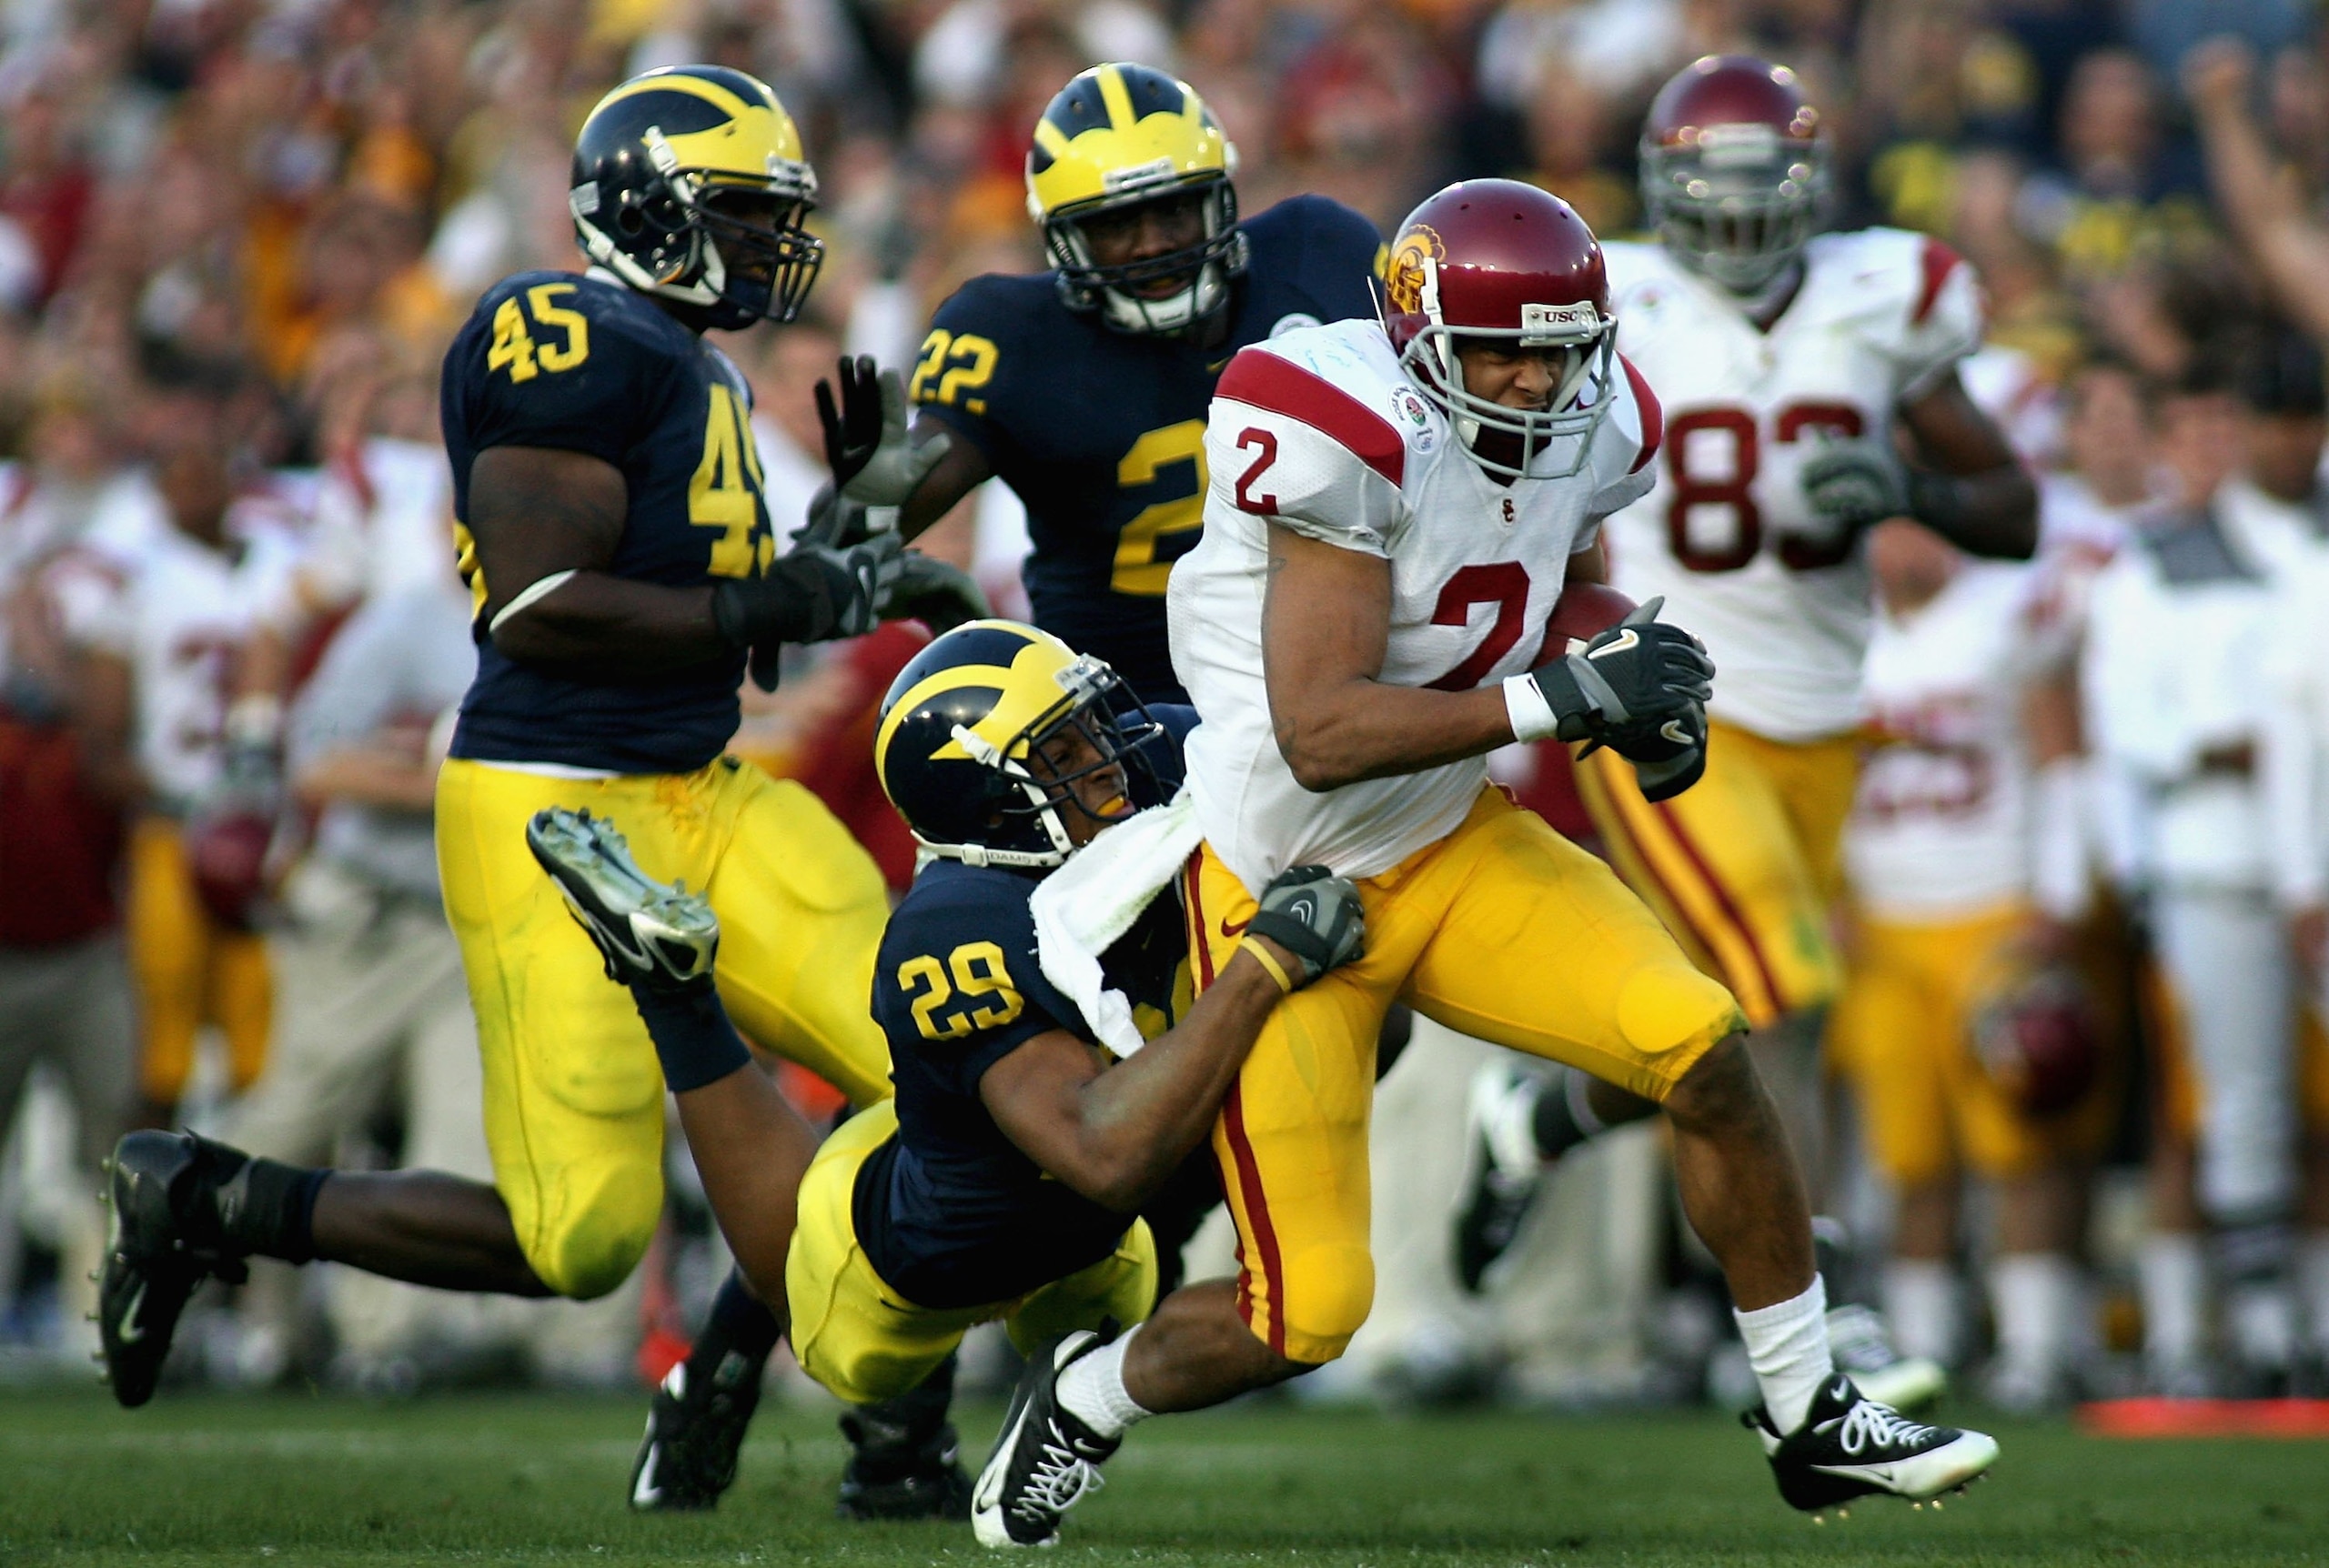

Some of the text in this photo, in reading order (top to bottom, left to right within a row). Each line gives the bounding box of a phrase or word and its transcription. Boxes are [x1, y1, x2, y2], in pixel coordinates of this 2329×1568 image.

[487, 283, 590, 383] 45
[1543, 310, 1578, 323] USC
[911, 328, 999, 415] 22
[1235, 427, 1279, 516] 2
[1420, 560, 1530, 691] 2
[897, 940, 1025, 1040] 29
